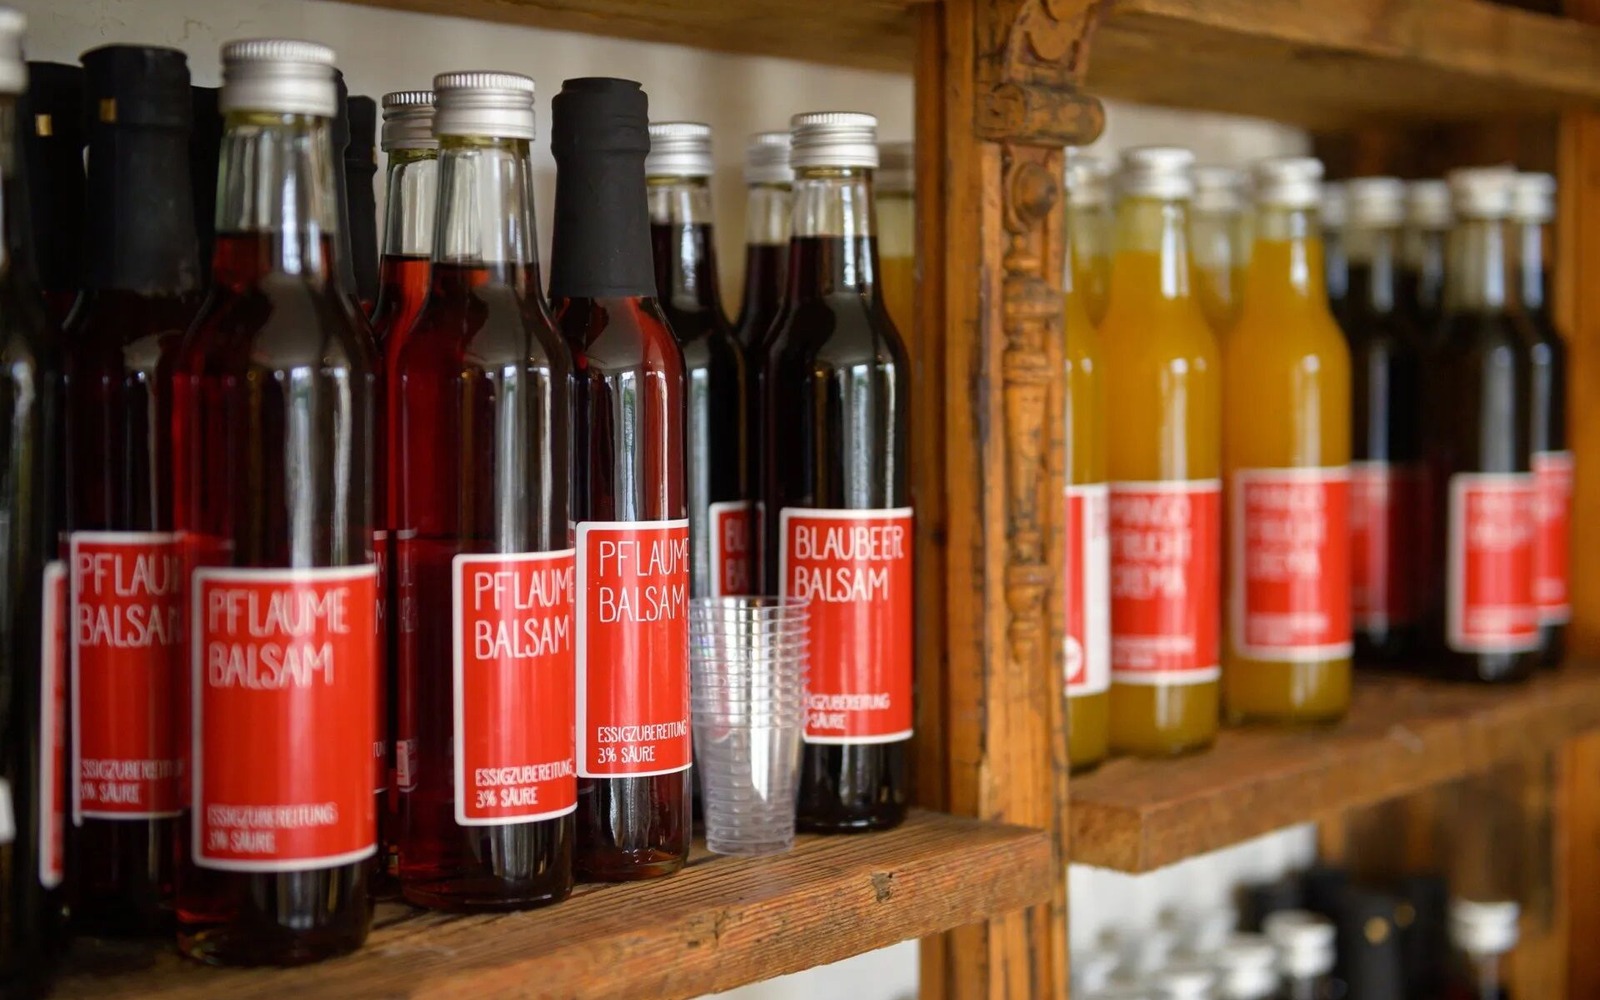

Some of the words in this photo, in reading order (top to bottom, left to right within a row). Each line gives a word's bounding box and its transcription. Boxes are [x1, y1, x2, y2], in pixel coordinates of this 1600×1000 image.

[599, 537, 689, 578] PFLAUME
[795, 525, 904, 561] BLAUBEER
[78, 552, 179, 597] PFLAU
[474, 566, 575, 611] PFLAUME
[794, 565, 889, 603] BALSAM
[208, 587, 351, 638] PFLAUME
[599, 583, 685, 623] BALSAM
[78, 603, 181, 648] BALSA
[474, 615, 570, 660] BALSAM
[208, 641, 334, 690] BALSAM
[597, 719, 687, 743] ESSIGZUBEREITUNG
[475, 758, 573, 787] ESSIGZUBEREITUNG
[597, 747, 617, 764] 3%
[621, 745, 656, 763] SÄURE
[475, 790, 497, 809] 3%
[500, 786, 539, 808] SÄURE
